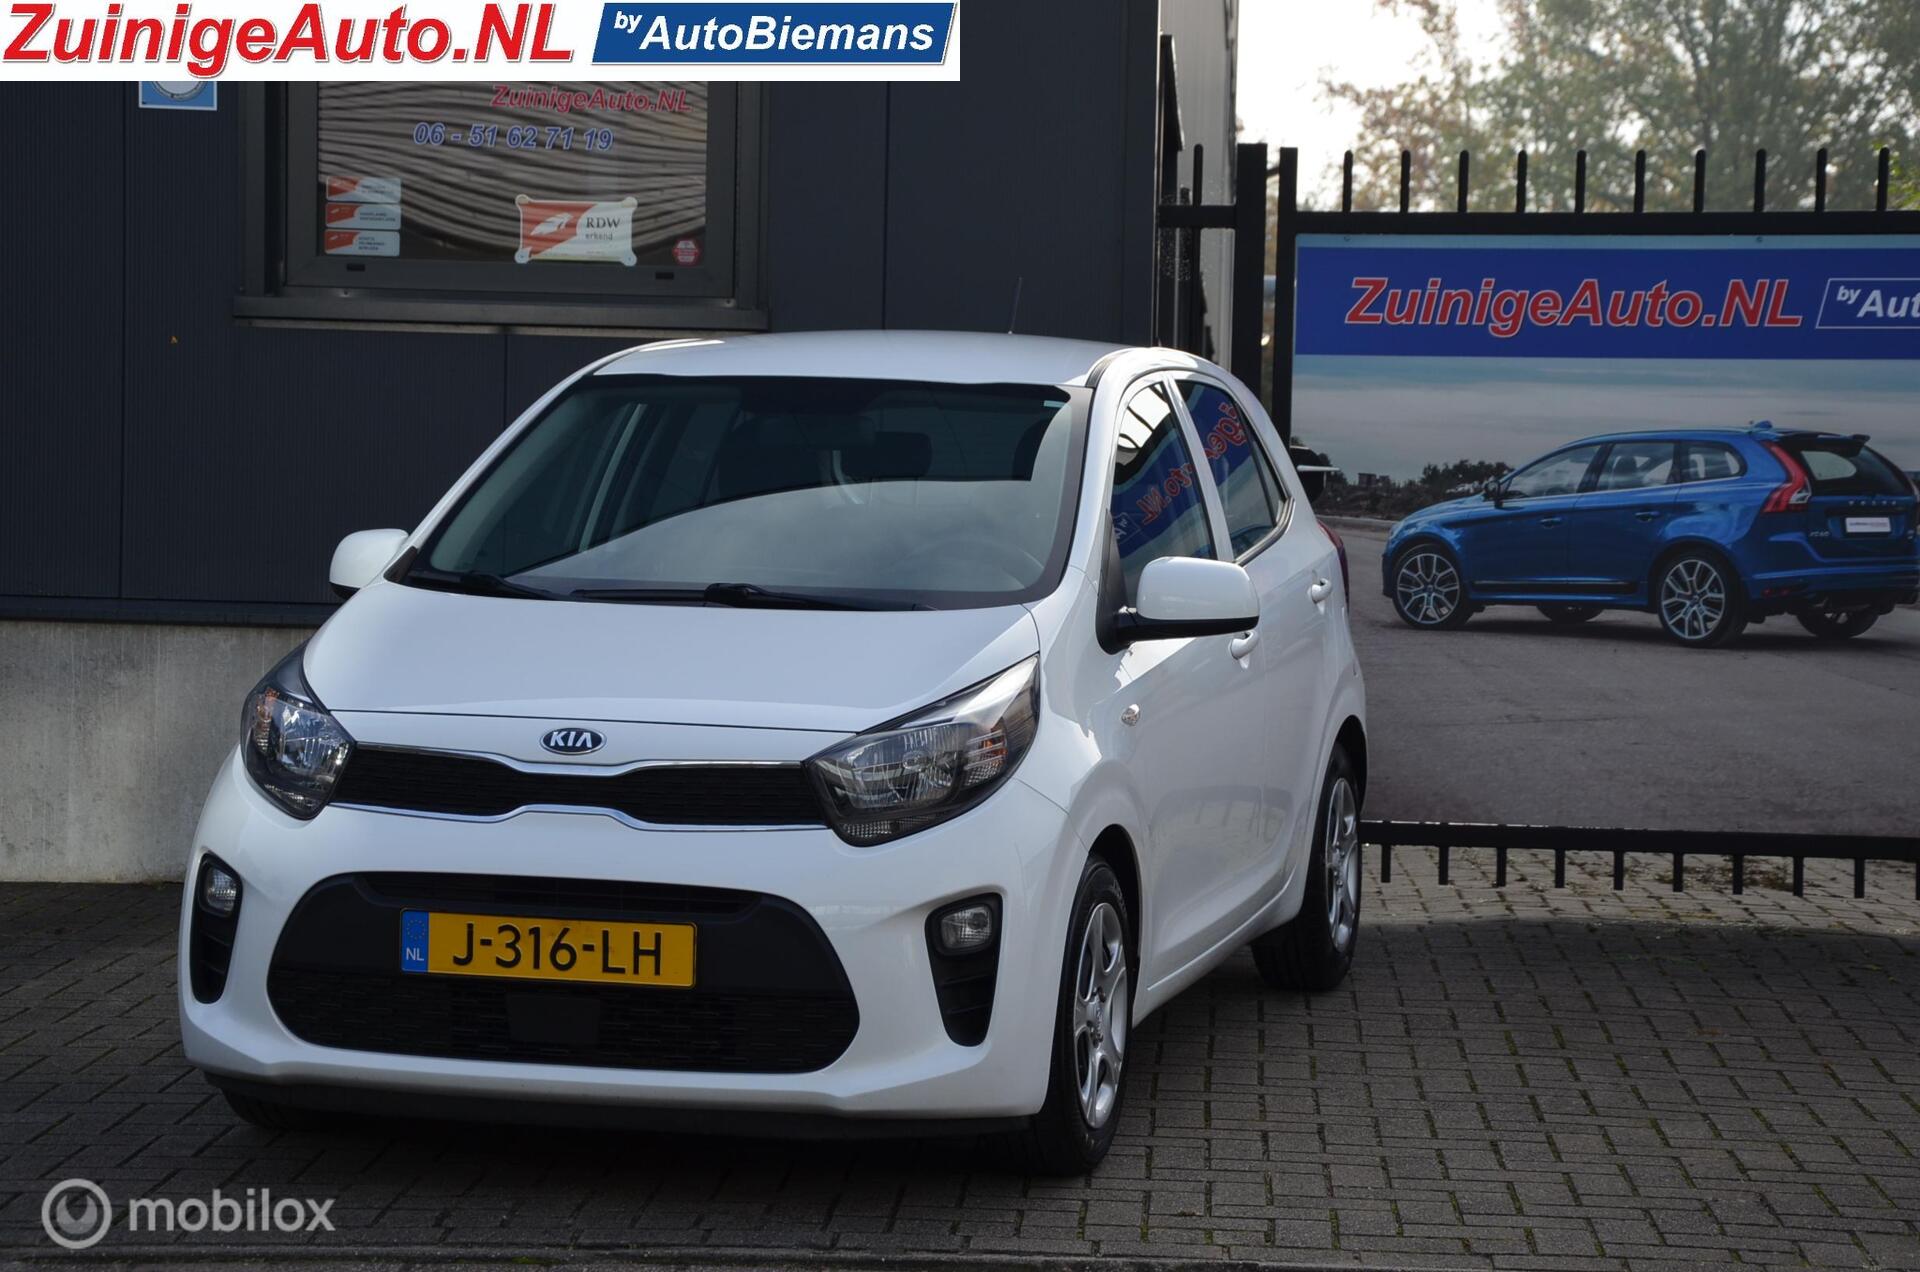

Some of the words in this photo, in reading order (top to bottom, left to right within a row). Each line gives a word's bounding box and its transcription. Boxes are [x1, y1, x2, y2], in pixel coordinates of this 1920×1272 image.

[490, 84, 694, 113] ZuinigeAuto.NL
[413, 122, 446, 145] 06
[469, 124, 499, 147] 51
[506, 126, 538, 149] 62
[545, 127, 575, 149] 71
[584, 128, 614, 150] 19
[585, 216, 621, 229] RDW
[1344, 276, 1803, 338] ZuinigeAuto.NL
[1836, 285, 1861, 305] by
[549, 730, 593, 749] KIA
[406, 947, 424, 961] NL
[452, 922, 662, 977] J-316-LH
